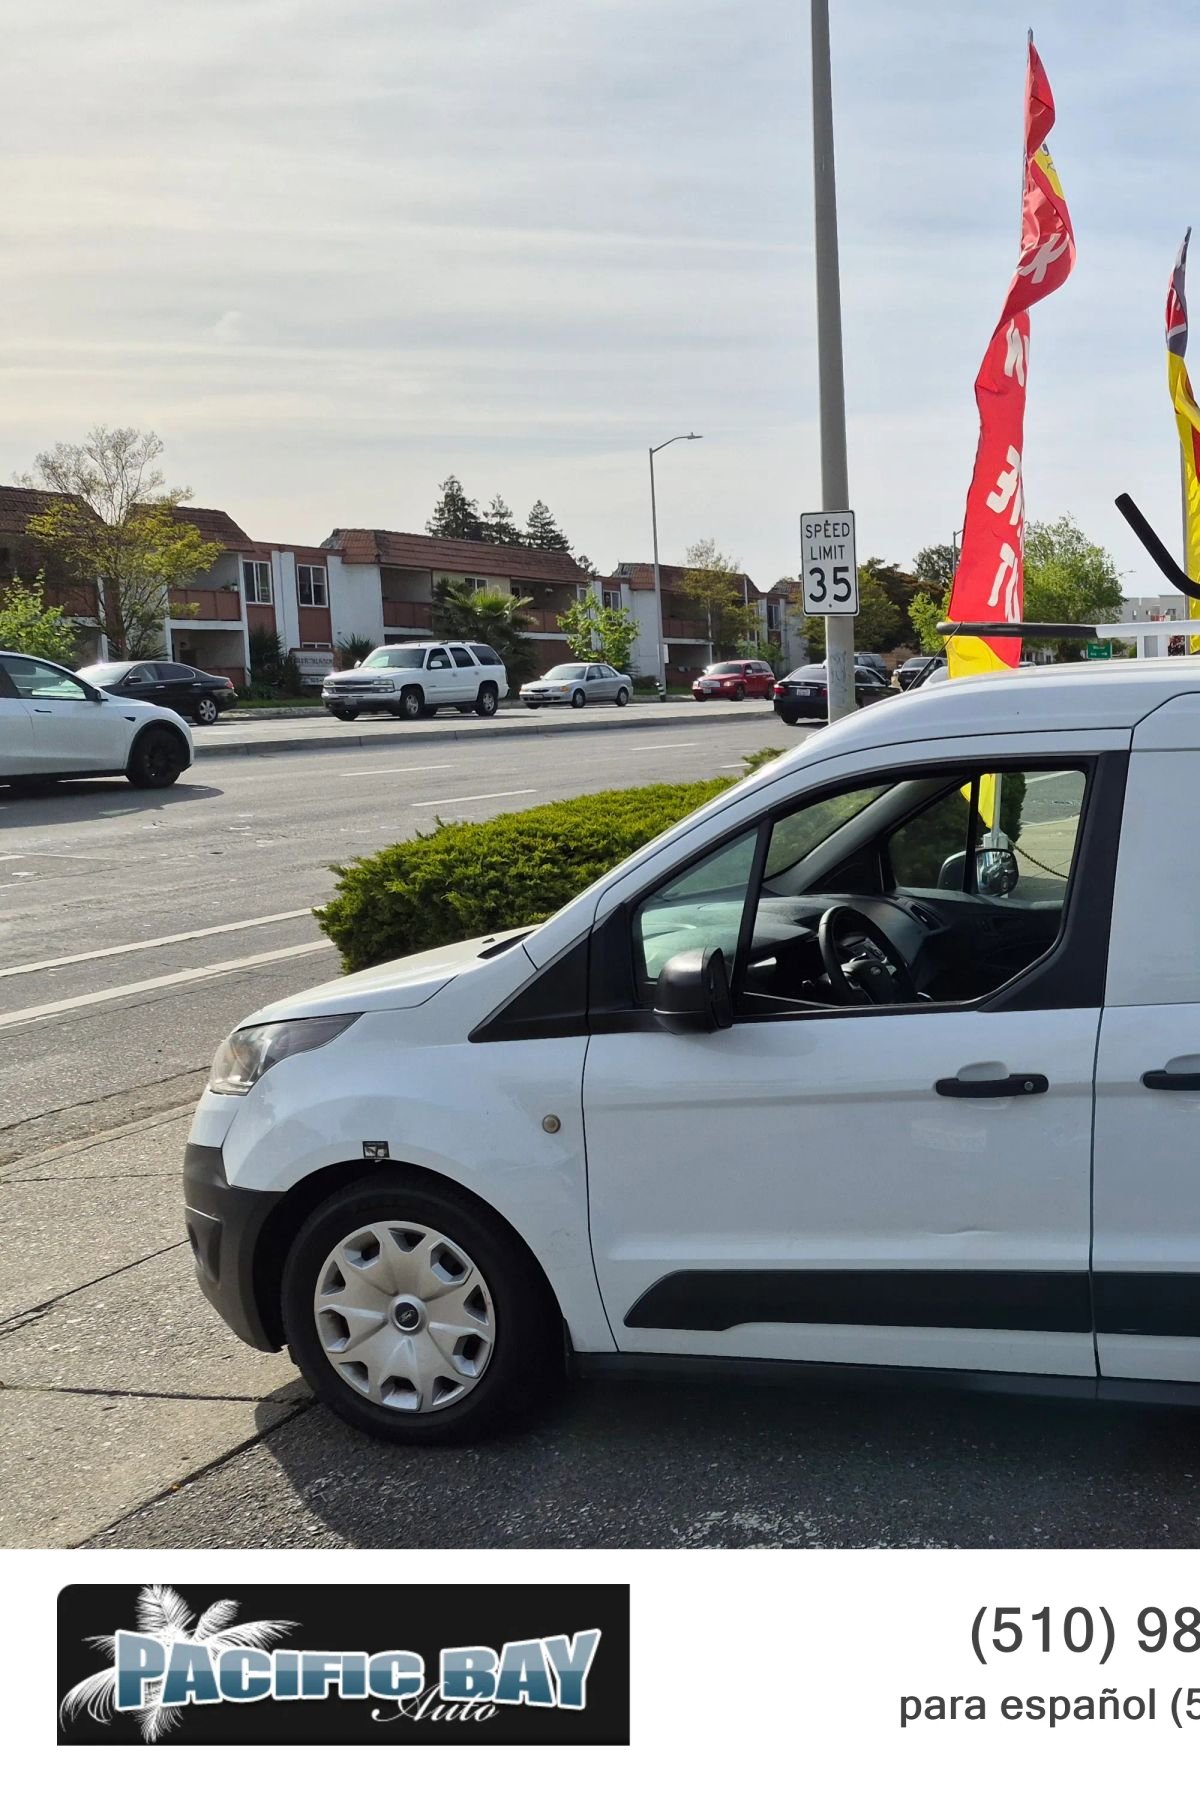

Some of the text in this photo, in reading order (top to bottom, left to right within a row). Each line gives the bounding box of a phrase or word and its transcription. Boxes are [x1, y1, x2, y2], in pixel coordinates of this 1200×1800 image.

[805, 522, 850, 539] SPEED
[810, 545, 845, 561] LIMIT
[809, 566, 852, 603] 35
